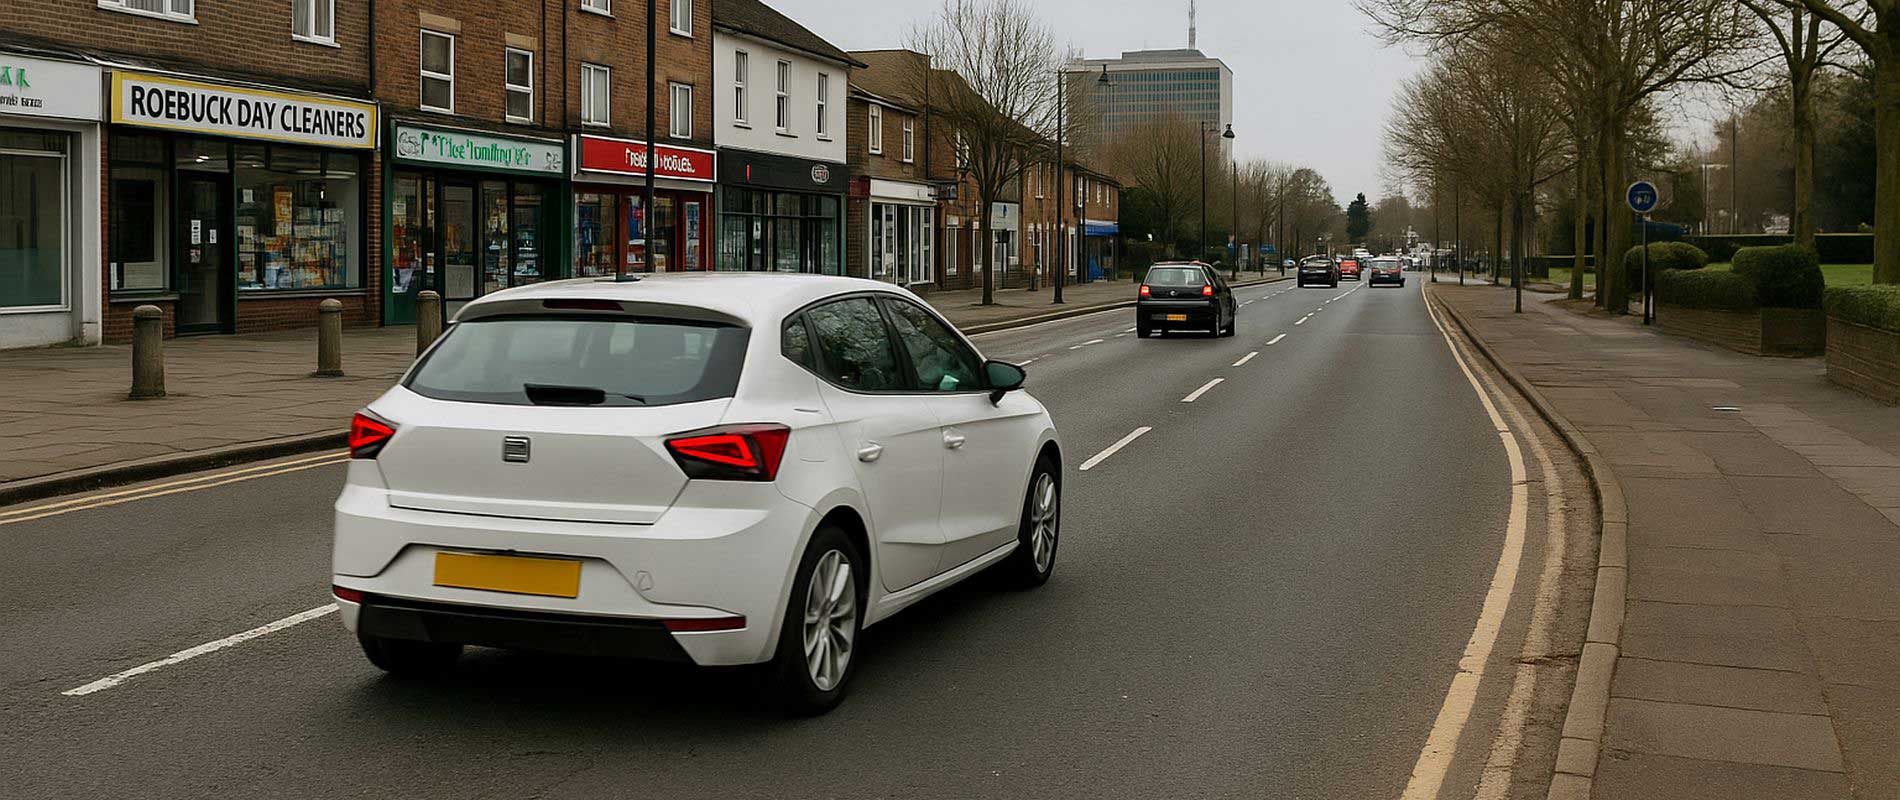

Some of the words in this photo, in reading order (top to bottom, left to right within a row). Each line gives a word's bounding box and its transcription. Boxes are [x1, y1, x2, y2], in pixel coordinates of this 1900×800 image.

[131, 85, 233, 125] ROEBUCK
[238, 99, 276, 130] DAY
[281, 105, 365, 139] CLEANERS
